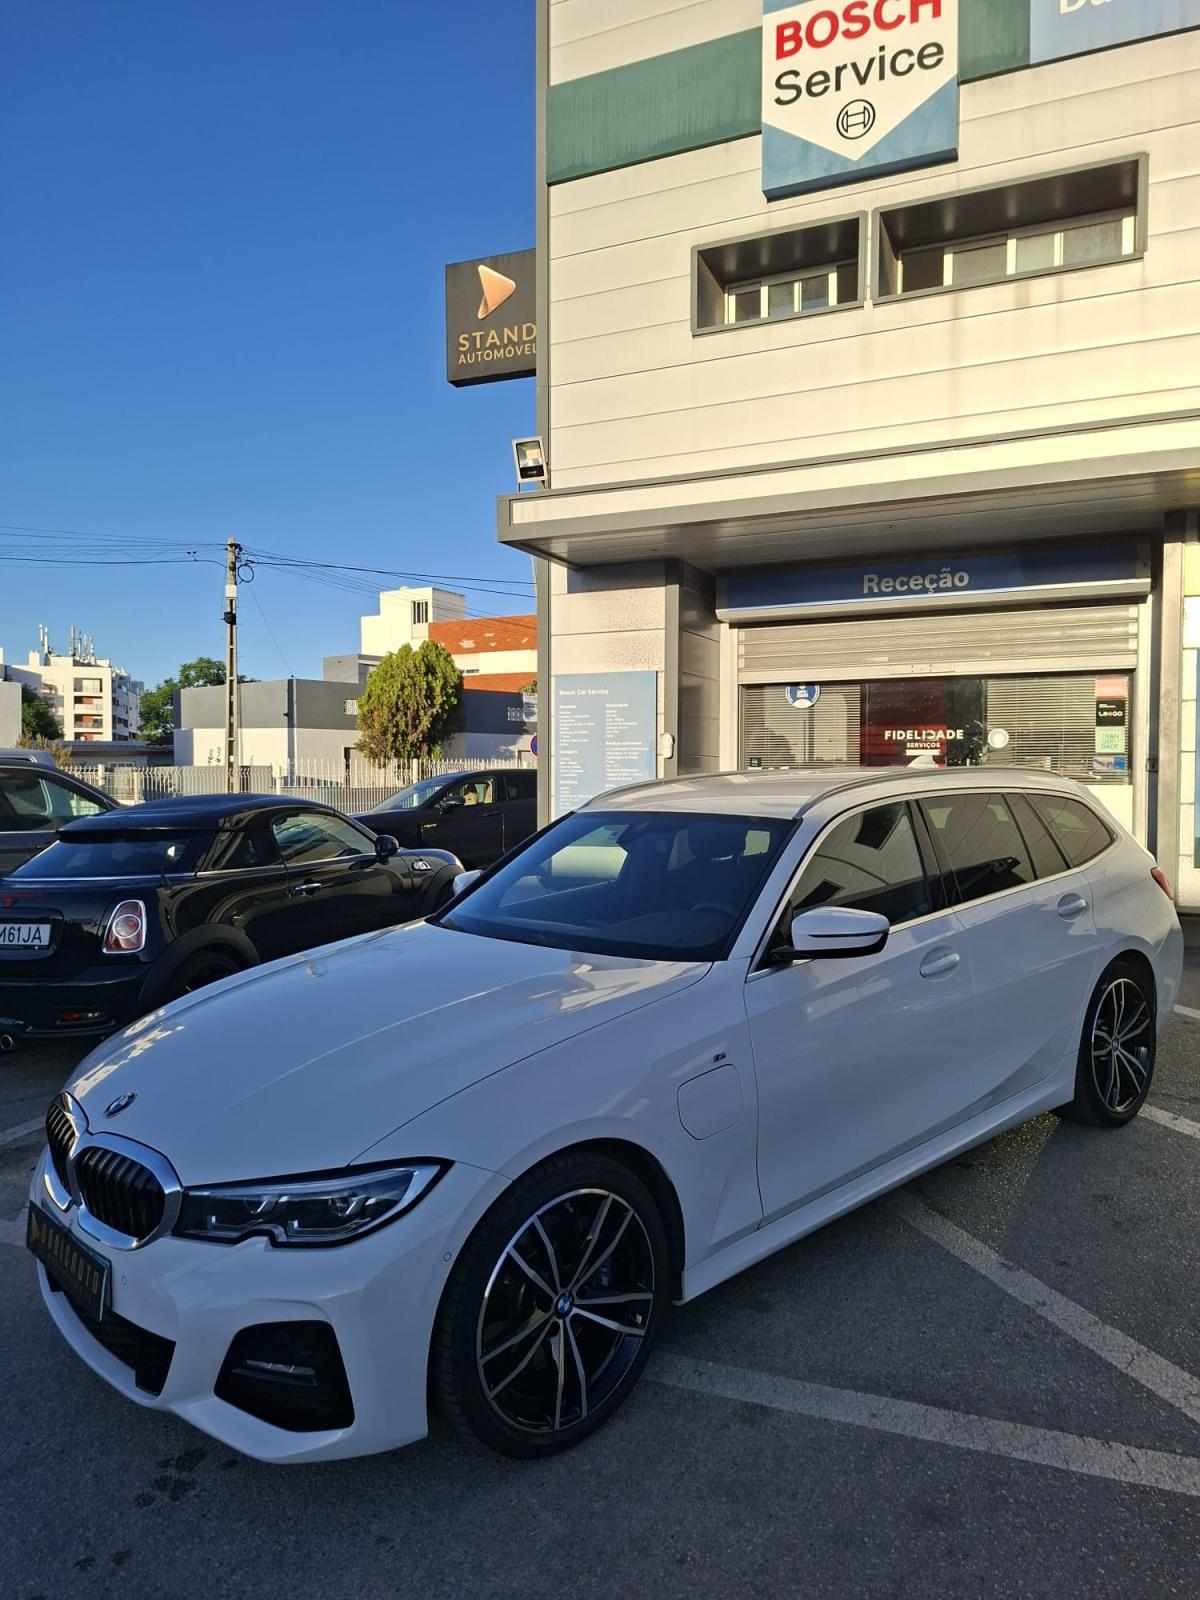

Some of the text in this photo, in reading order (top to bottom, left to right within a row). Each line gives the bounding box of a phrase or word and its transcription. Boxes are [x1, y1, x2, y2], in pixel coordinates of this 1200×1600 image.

[775, 0, 942, 61] BOSCH
[774, 42, 945, 106] Service
[458, 322, 537, 351] STAND
[863, 567, 969, 594] Receção
[884, 729, 965, 742] FIDELIDADE
[906, 741, 941, 749] SERVIÇOS
